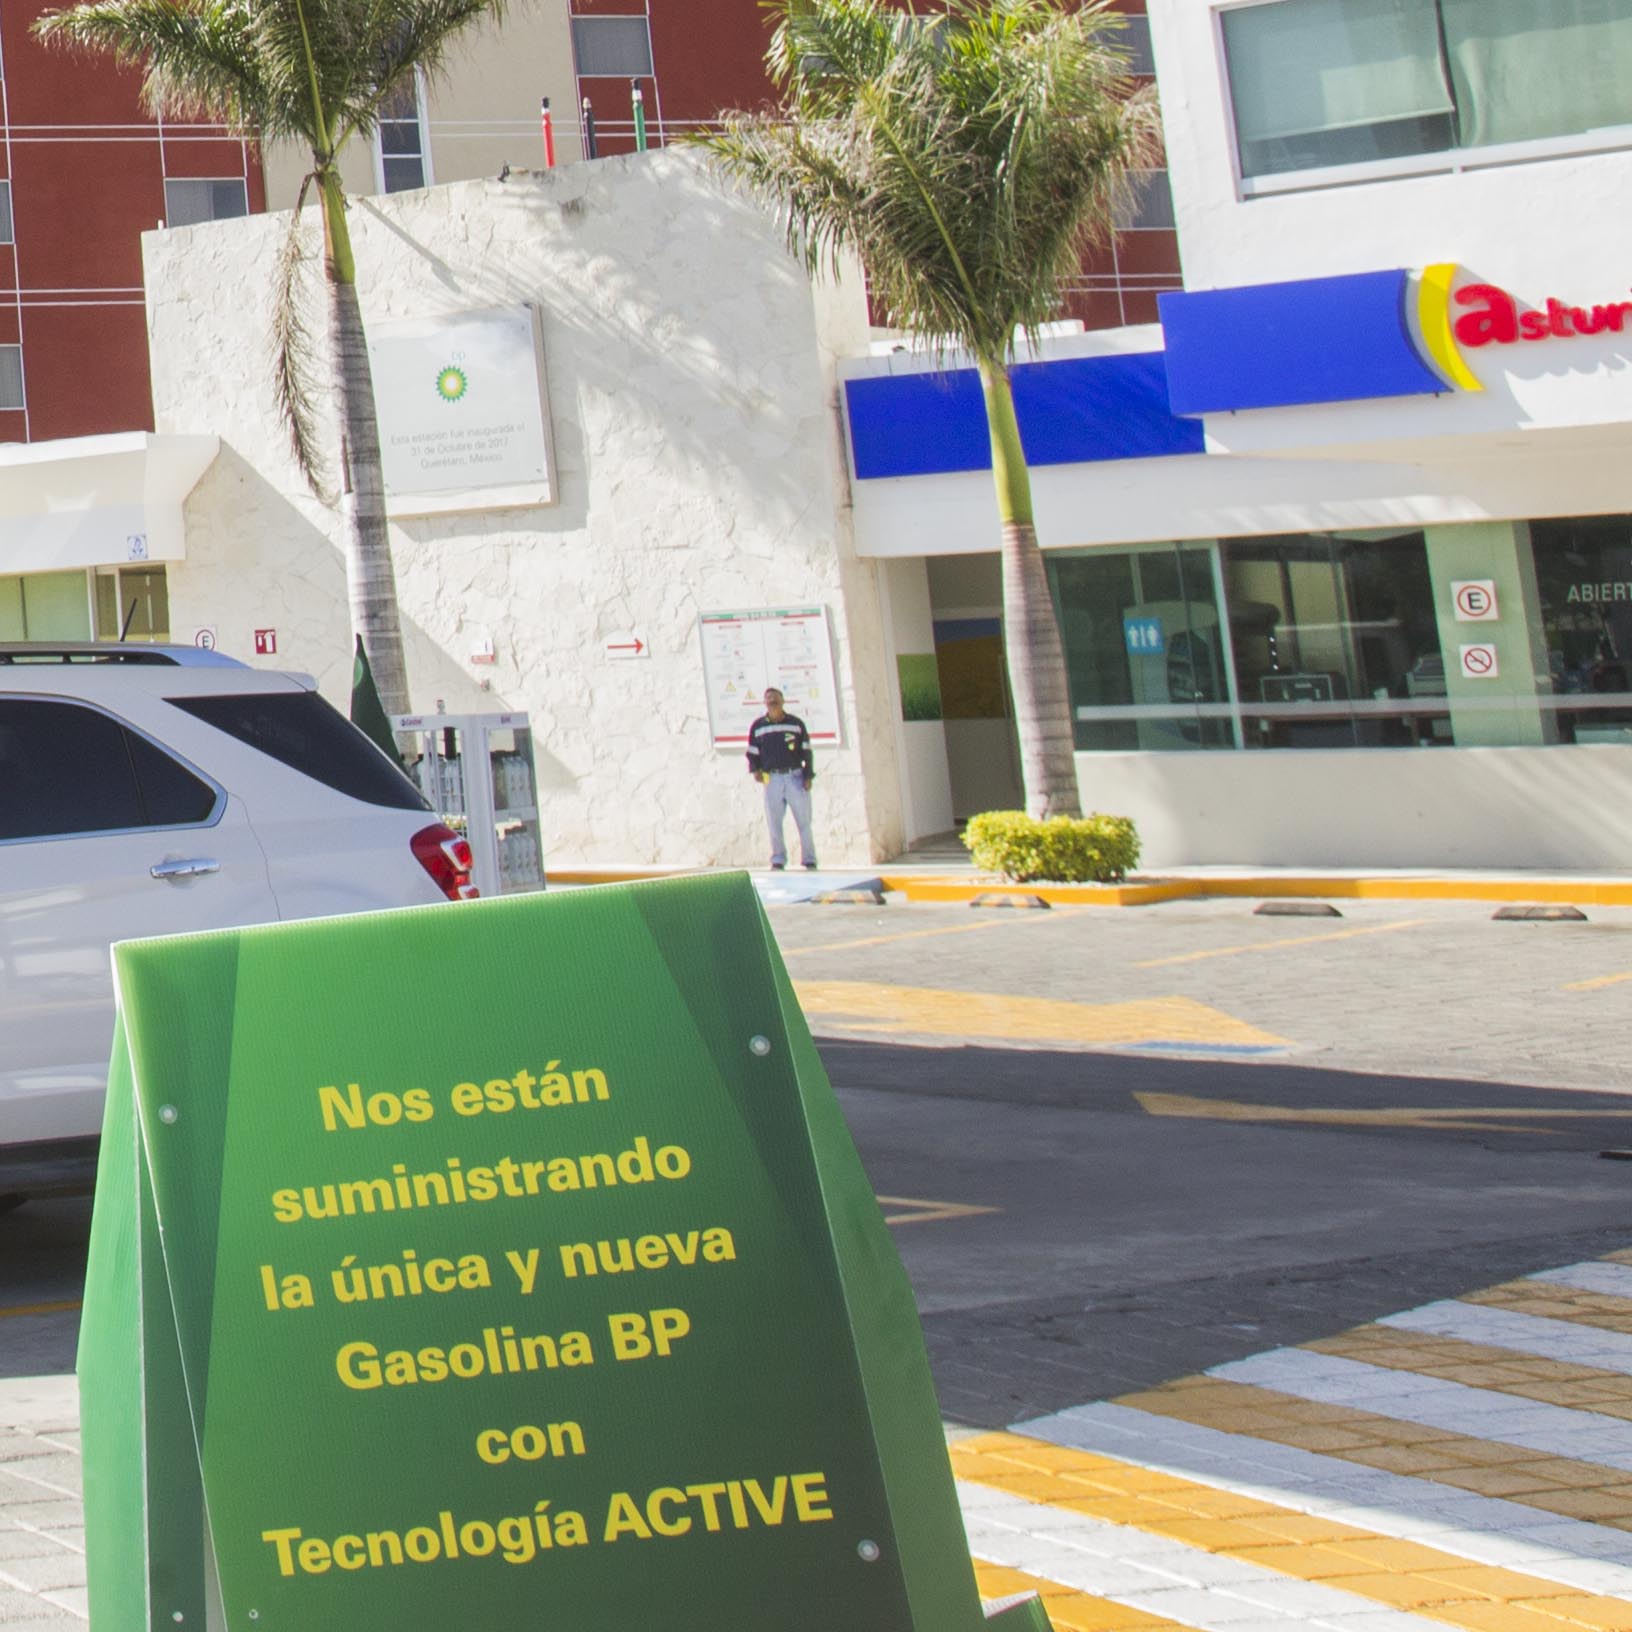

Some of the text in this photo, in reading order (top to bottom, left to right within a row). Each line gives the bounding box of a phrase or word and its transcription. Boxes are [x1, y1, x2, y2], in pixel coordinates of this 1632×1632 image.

[1455, 284, 1632, 347] astur
[1467, 592, 1483, 610] E
[318, 1059, 609, 1131] Nos están
[270, 1136, 691, 1224] suministrando
[260, 1224, 737, 1310] la única y nueva
[335, 1308, 692, 1390] Gasolina BP
[475, 1414, 585, 1464] con
[262, 1472, 834, 1577] Tecnología ACTIVE
